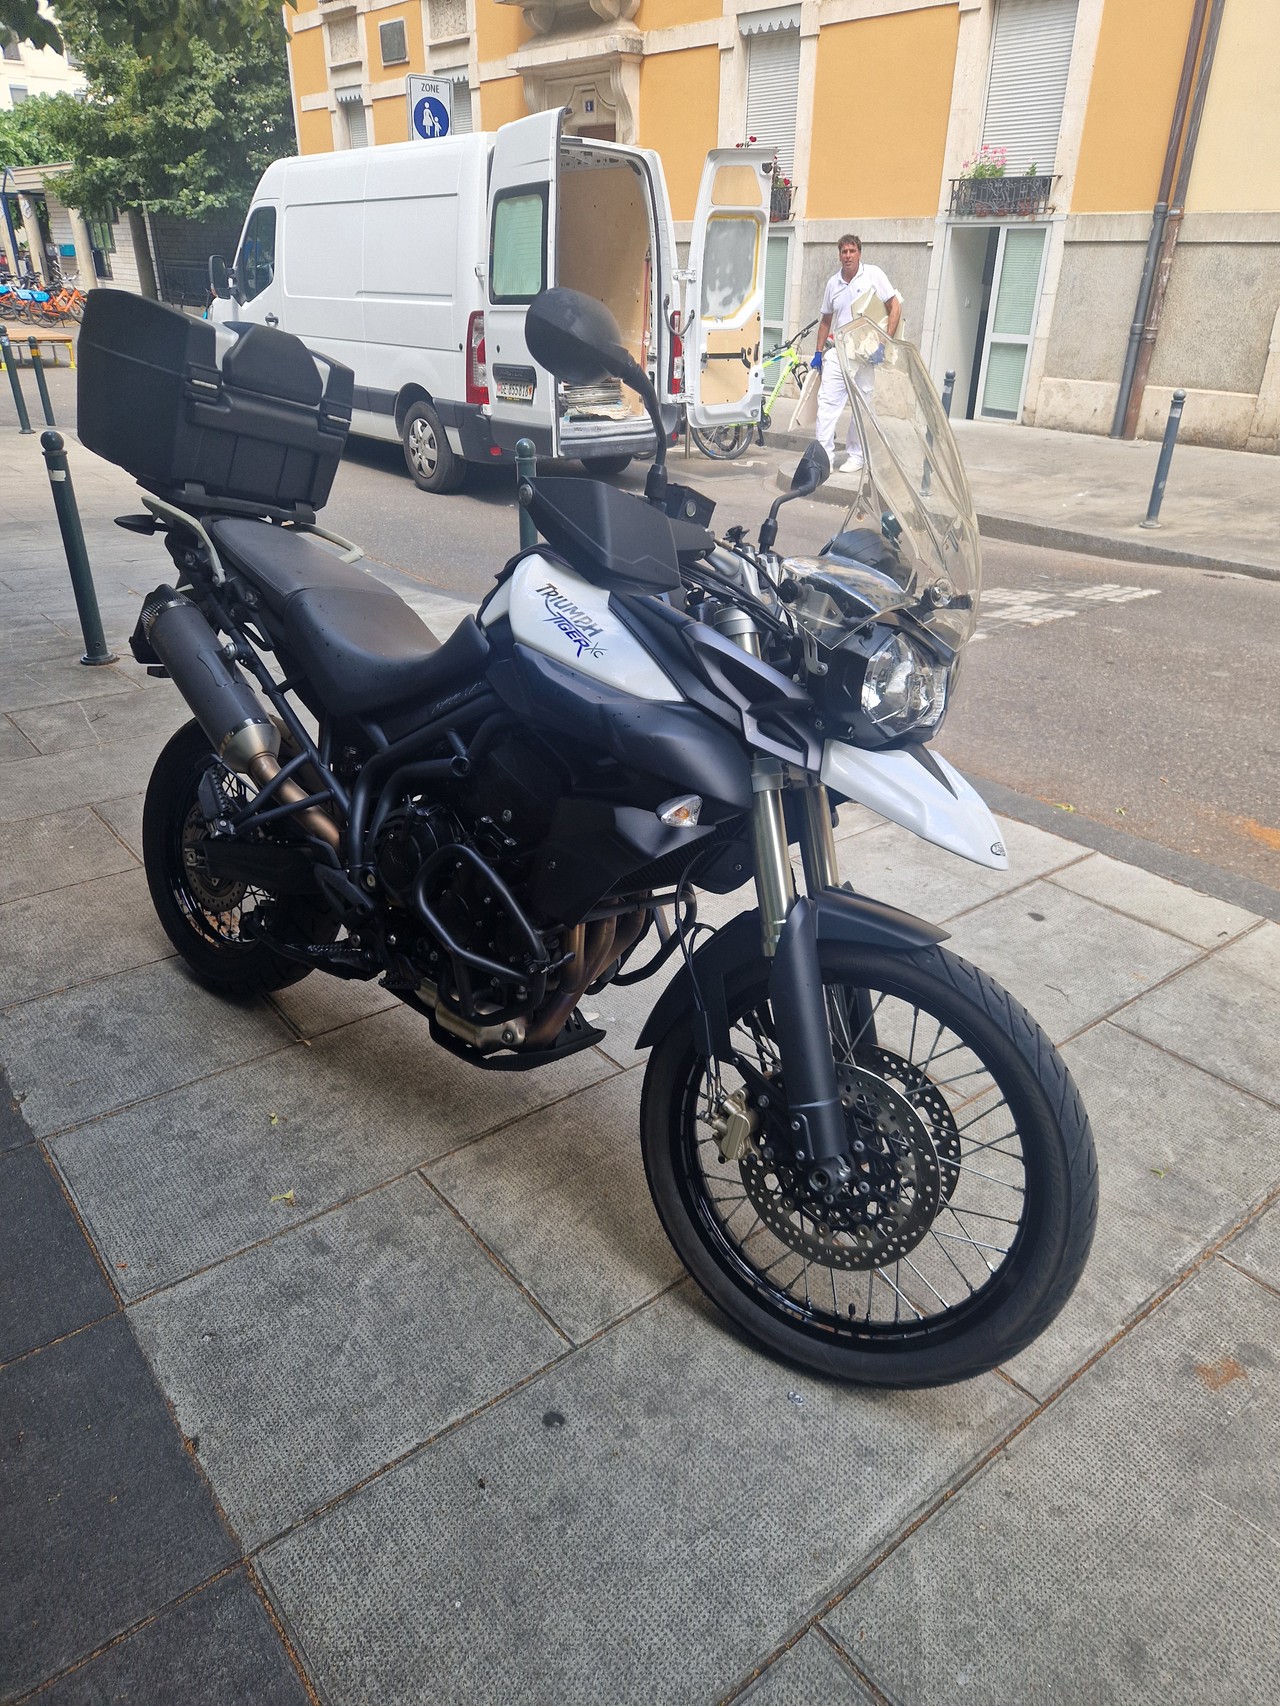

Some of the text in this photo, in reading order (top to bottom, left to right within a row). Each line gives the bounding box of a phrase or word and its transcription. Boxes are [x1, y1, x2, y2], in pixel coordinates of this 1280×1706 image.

[421, 83, 439, 93] ZONE
[535, 583, 604, 637] TRIUMPH
[542, 611, 608, 658] TIGER XC
